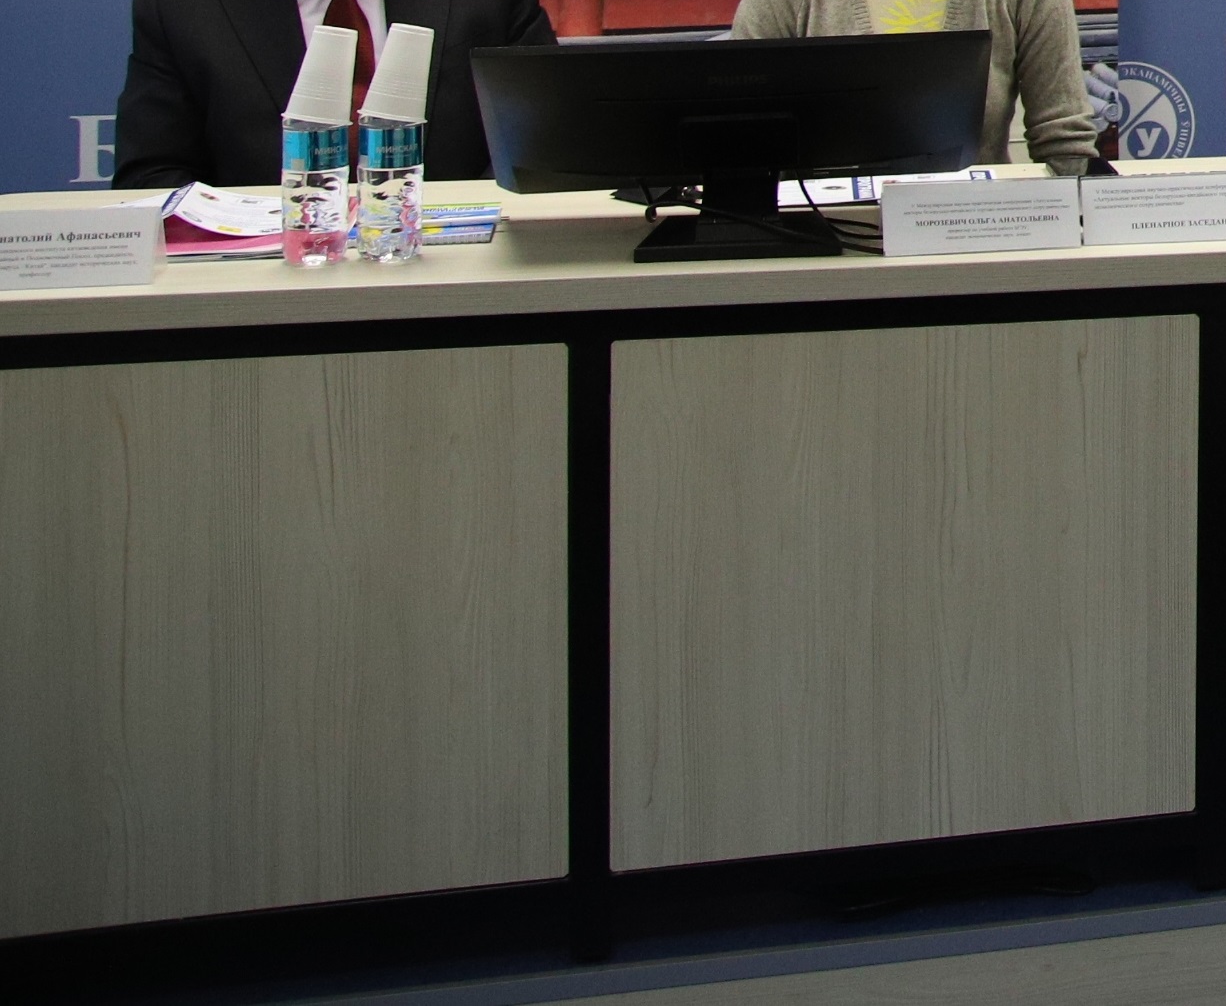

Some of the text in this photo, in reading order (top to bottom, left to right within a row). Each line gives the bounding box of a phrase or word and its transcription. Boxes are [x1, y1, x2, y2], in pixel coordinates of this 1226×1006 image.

[915, 214, 1060, 227] МОРОЗЕВИЧ ОЛЬГА АНАТОЛЬЕВНА
[1132, 220, 1186, 230] ПЛЕНАРНОЕ
[0, 230, 142, 244] натолий Афанасьевич
